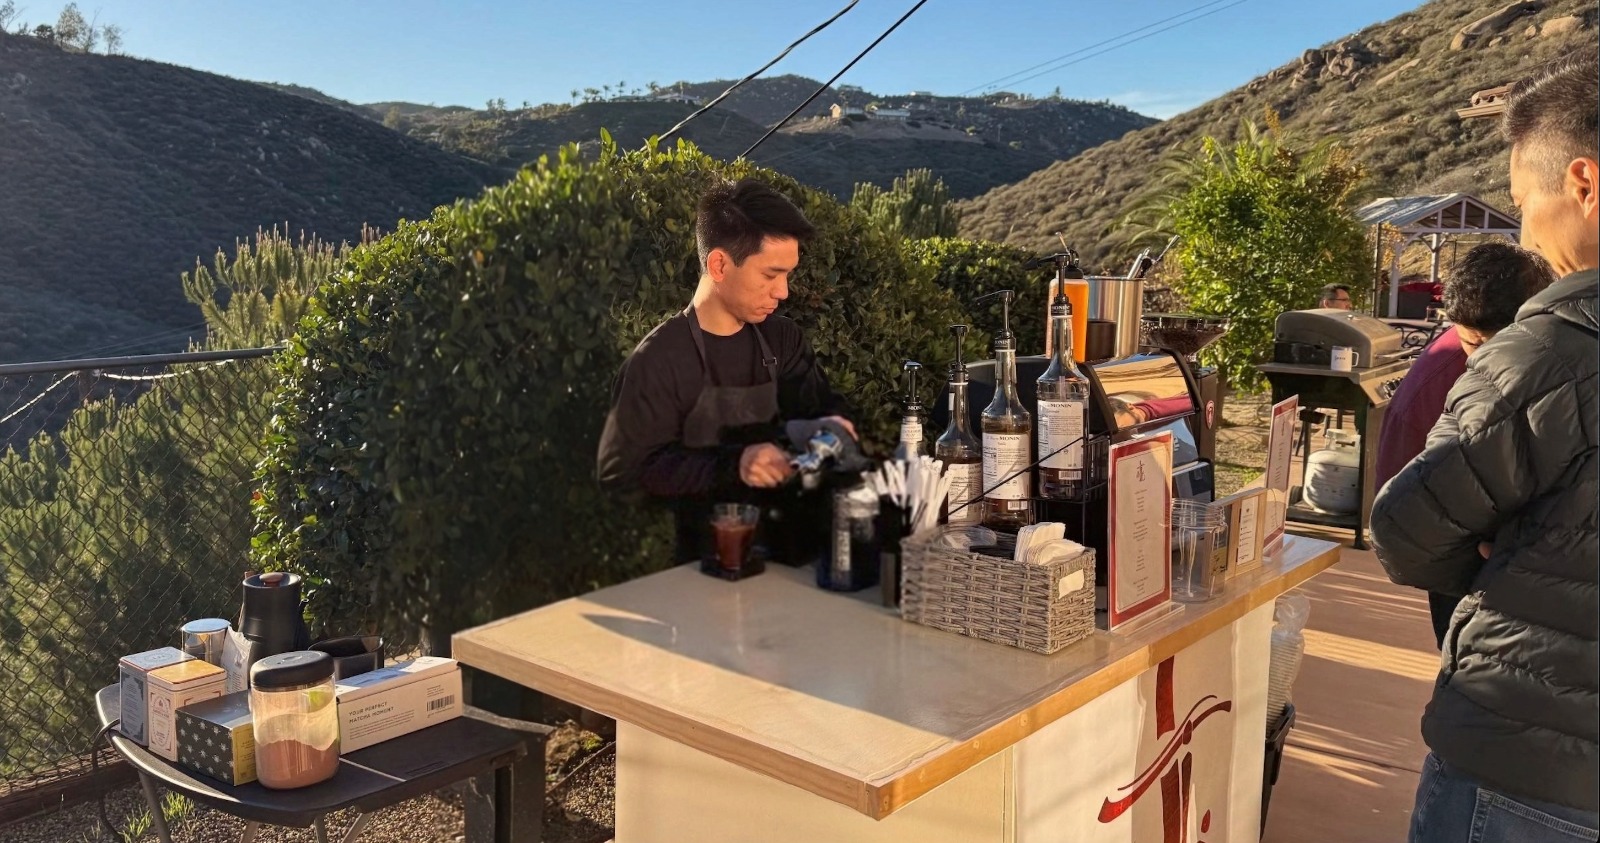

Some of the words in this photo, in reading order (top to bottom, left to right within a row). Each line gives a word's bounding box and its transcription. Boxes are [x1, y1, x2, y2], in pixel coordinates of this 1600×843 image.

[349, 708, 364, 716] YOUR
[364, 701, 387, 712] PERFECT
[349, 713, 370, 724] MATCHA
[371, 706, 394, 717] MOMENT
